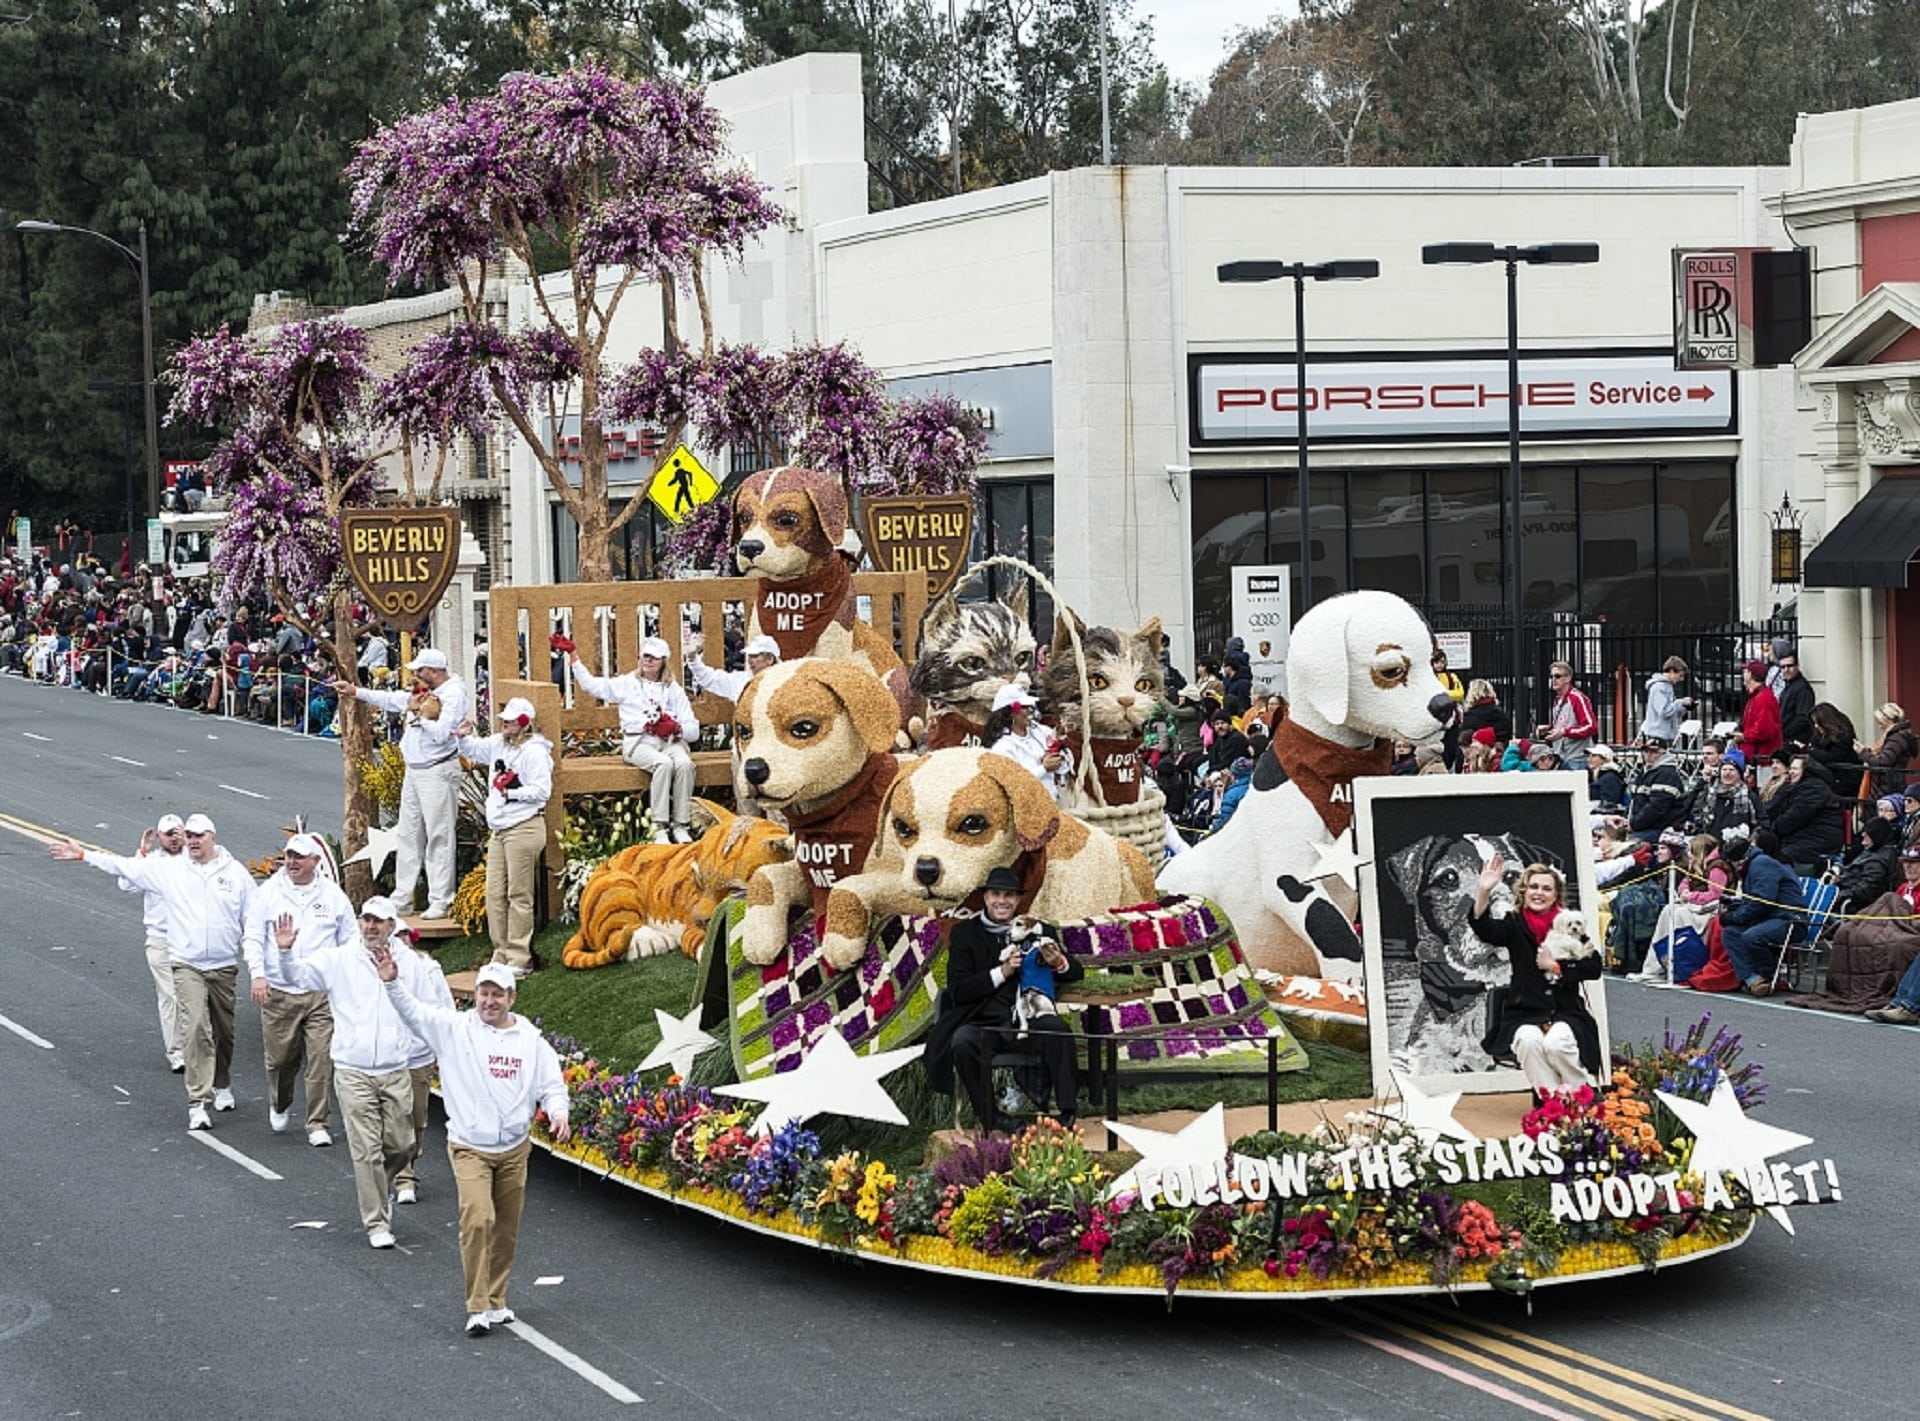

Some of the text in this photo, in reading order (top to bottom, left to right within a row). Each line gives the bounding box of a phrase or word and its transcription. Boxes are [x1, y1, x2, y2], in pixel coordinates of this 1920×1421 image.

[1688, 260, 1734, 273] ROLLS
[1690, 344, 1735, 359] ROYCE
[1217, 381, 1682, 412] PORSCHE Service
[353, 526, 445, 553] BEVERLY
[878, 513, 964, 541] BEVERLY
[368, 556, 430, 583] HILLS
[892, 546, 951, 572] HILLS
[763, 591, 825, 611] ADOPT
[776, 615, 805, 631] ME
[1134, 1152, 1309, 1212] FOLLOW
[1329, 1143, 1416, 1191] THE
[1550, 1170, 1682, 1224] ADOPT
[1703, 1169, 1735, 1211] A
